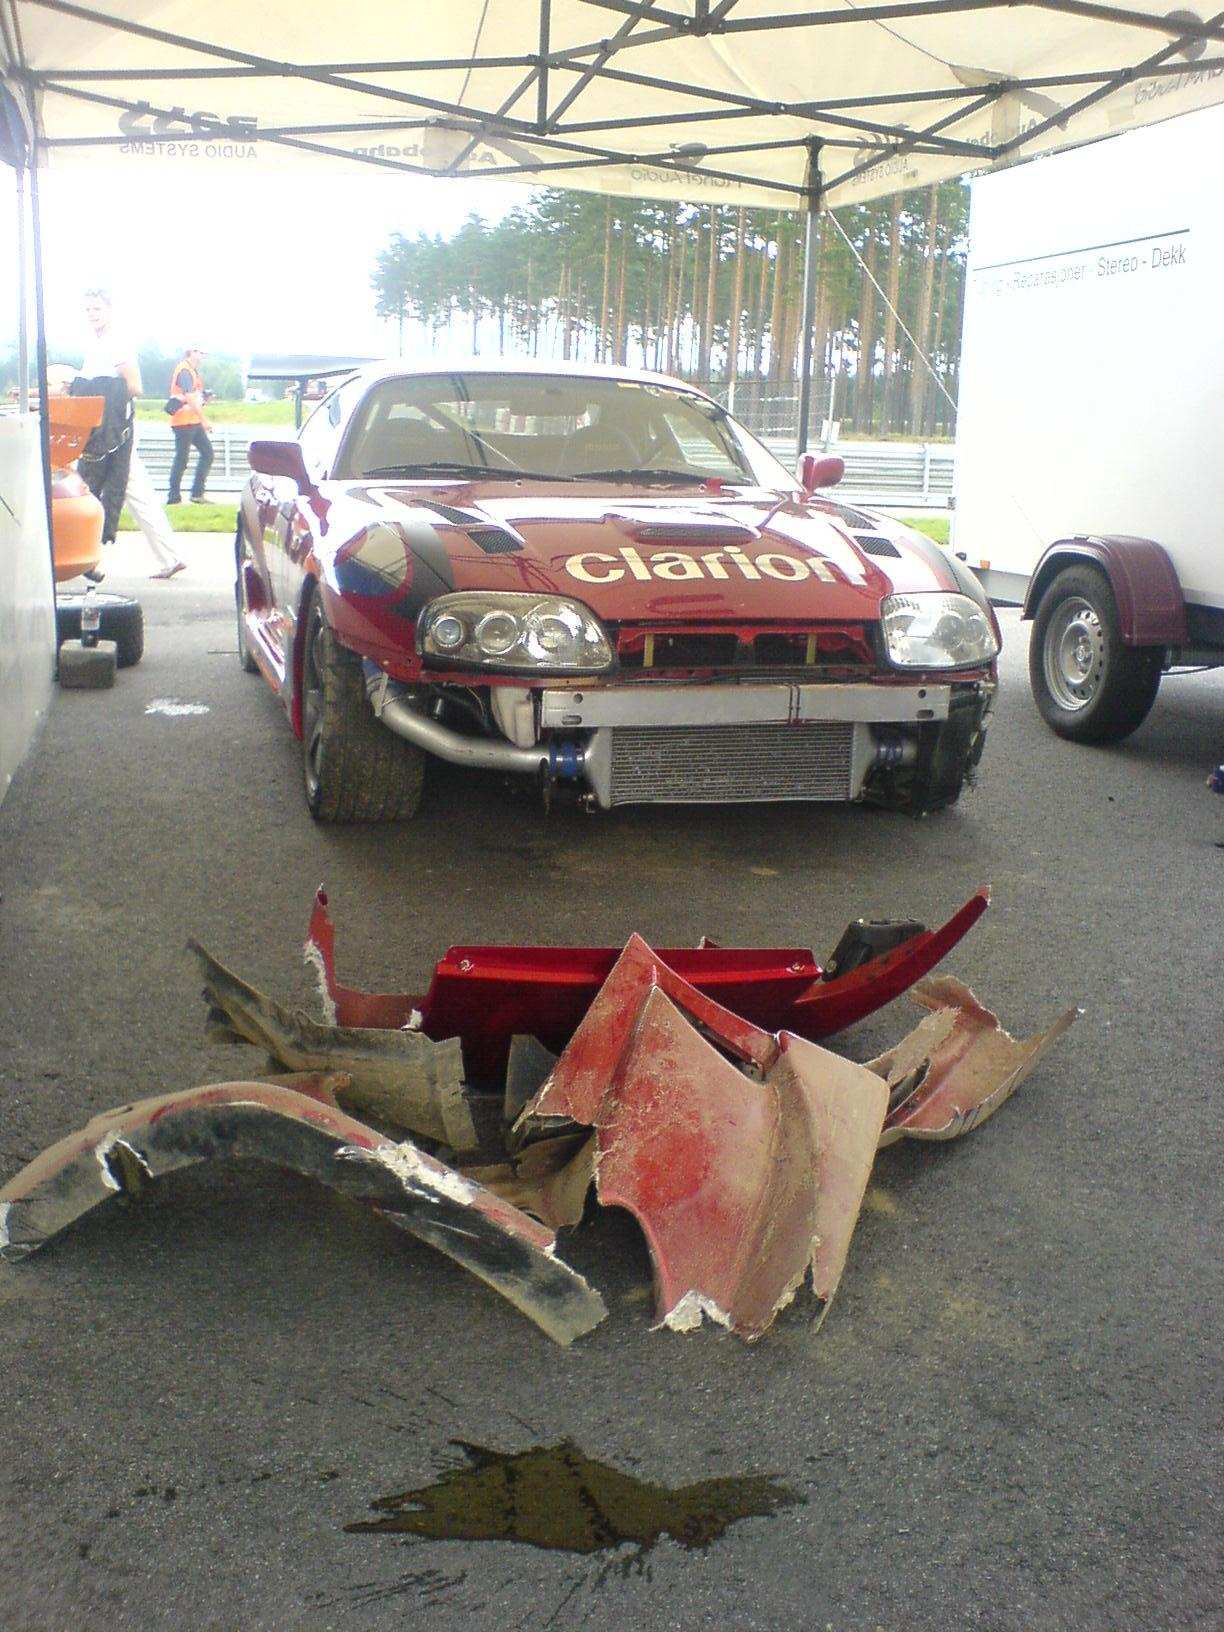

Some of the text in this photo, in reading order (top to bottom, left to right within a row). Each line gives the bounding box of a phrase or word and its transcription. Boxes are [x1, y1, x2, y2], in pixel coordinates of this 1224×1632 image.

[1097, 254, 1138, 278] Stereo
[1151, 243, 1187, 269] Dekk
[565, 545, 868, 586] clarion
